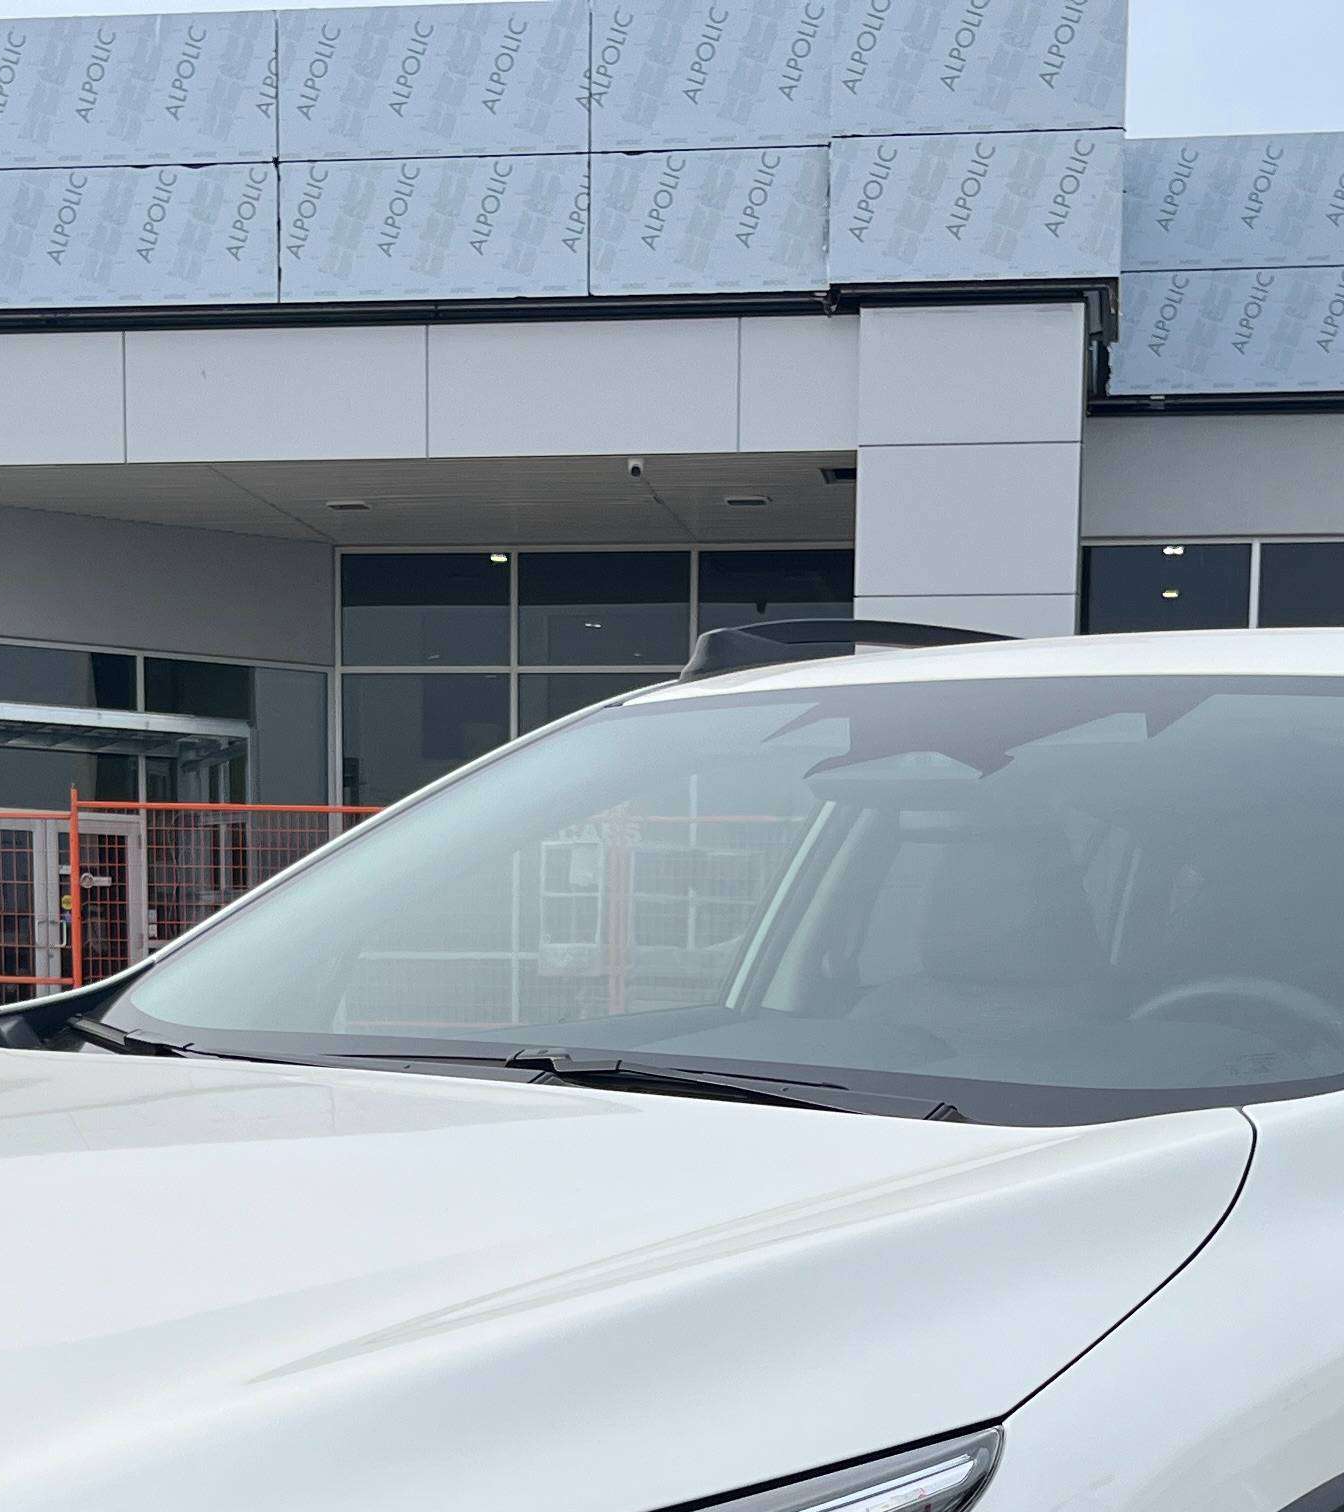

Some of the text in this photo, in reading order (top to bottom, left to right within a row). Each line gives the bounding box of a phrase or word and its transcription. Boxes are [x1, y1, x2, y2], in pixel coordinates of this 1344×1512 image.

[75, 27, 116, 124] ALPOLIC
[165, 24, 207, 121] ALPOLIC
[296, 23, 341, 121] ALPOLIC
[388, 20, 435, 117] ALPOLIC
[482, 17, 528, 115] ALPOLIC
[591, 9, 634, 107] ALPOLIC
[682, 5, 729, 105] ALPOLIC
[778, 0, 825, 101] ALPOLIC
[47, 172, 88, 266] ALPOLIC
[136, 169, 177, 264] ALPOLIC
[226, 167, 268, 261] ALPOLIC
[286, 165, 329, 260] ALPOLIC
[377, 163, 420, 258] ALPOLIC
[469, 160, 513, 256] ALPOLIC
[640, 155, 686, 251] ALPOLIC
[735, 151, 781, 249] ALPOLIC
[848, 144, 898, 243] ALPOLIC
[945, 141, 996, 241] ALPOLIC
[1044, 138, 1096, 238] ALPOLIC
[1157, 147, 1199, 232] ALPOLIC
[1241, 144, 1284, 230] ALPOLIC
[1148, 274, 1190, 358] ALPOLIC
[1232, 271, 1275, 356] ALPOLIC
